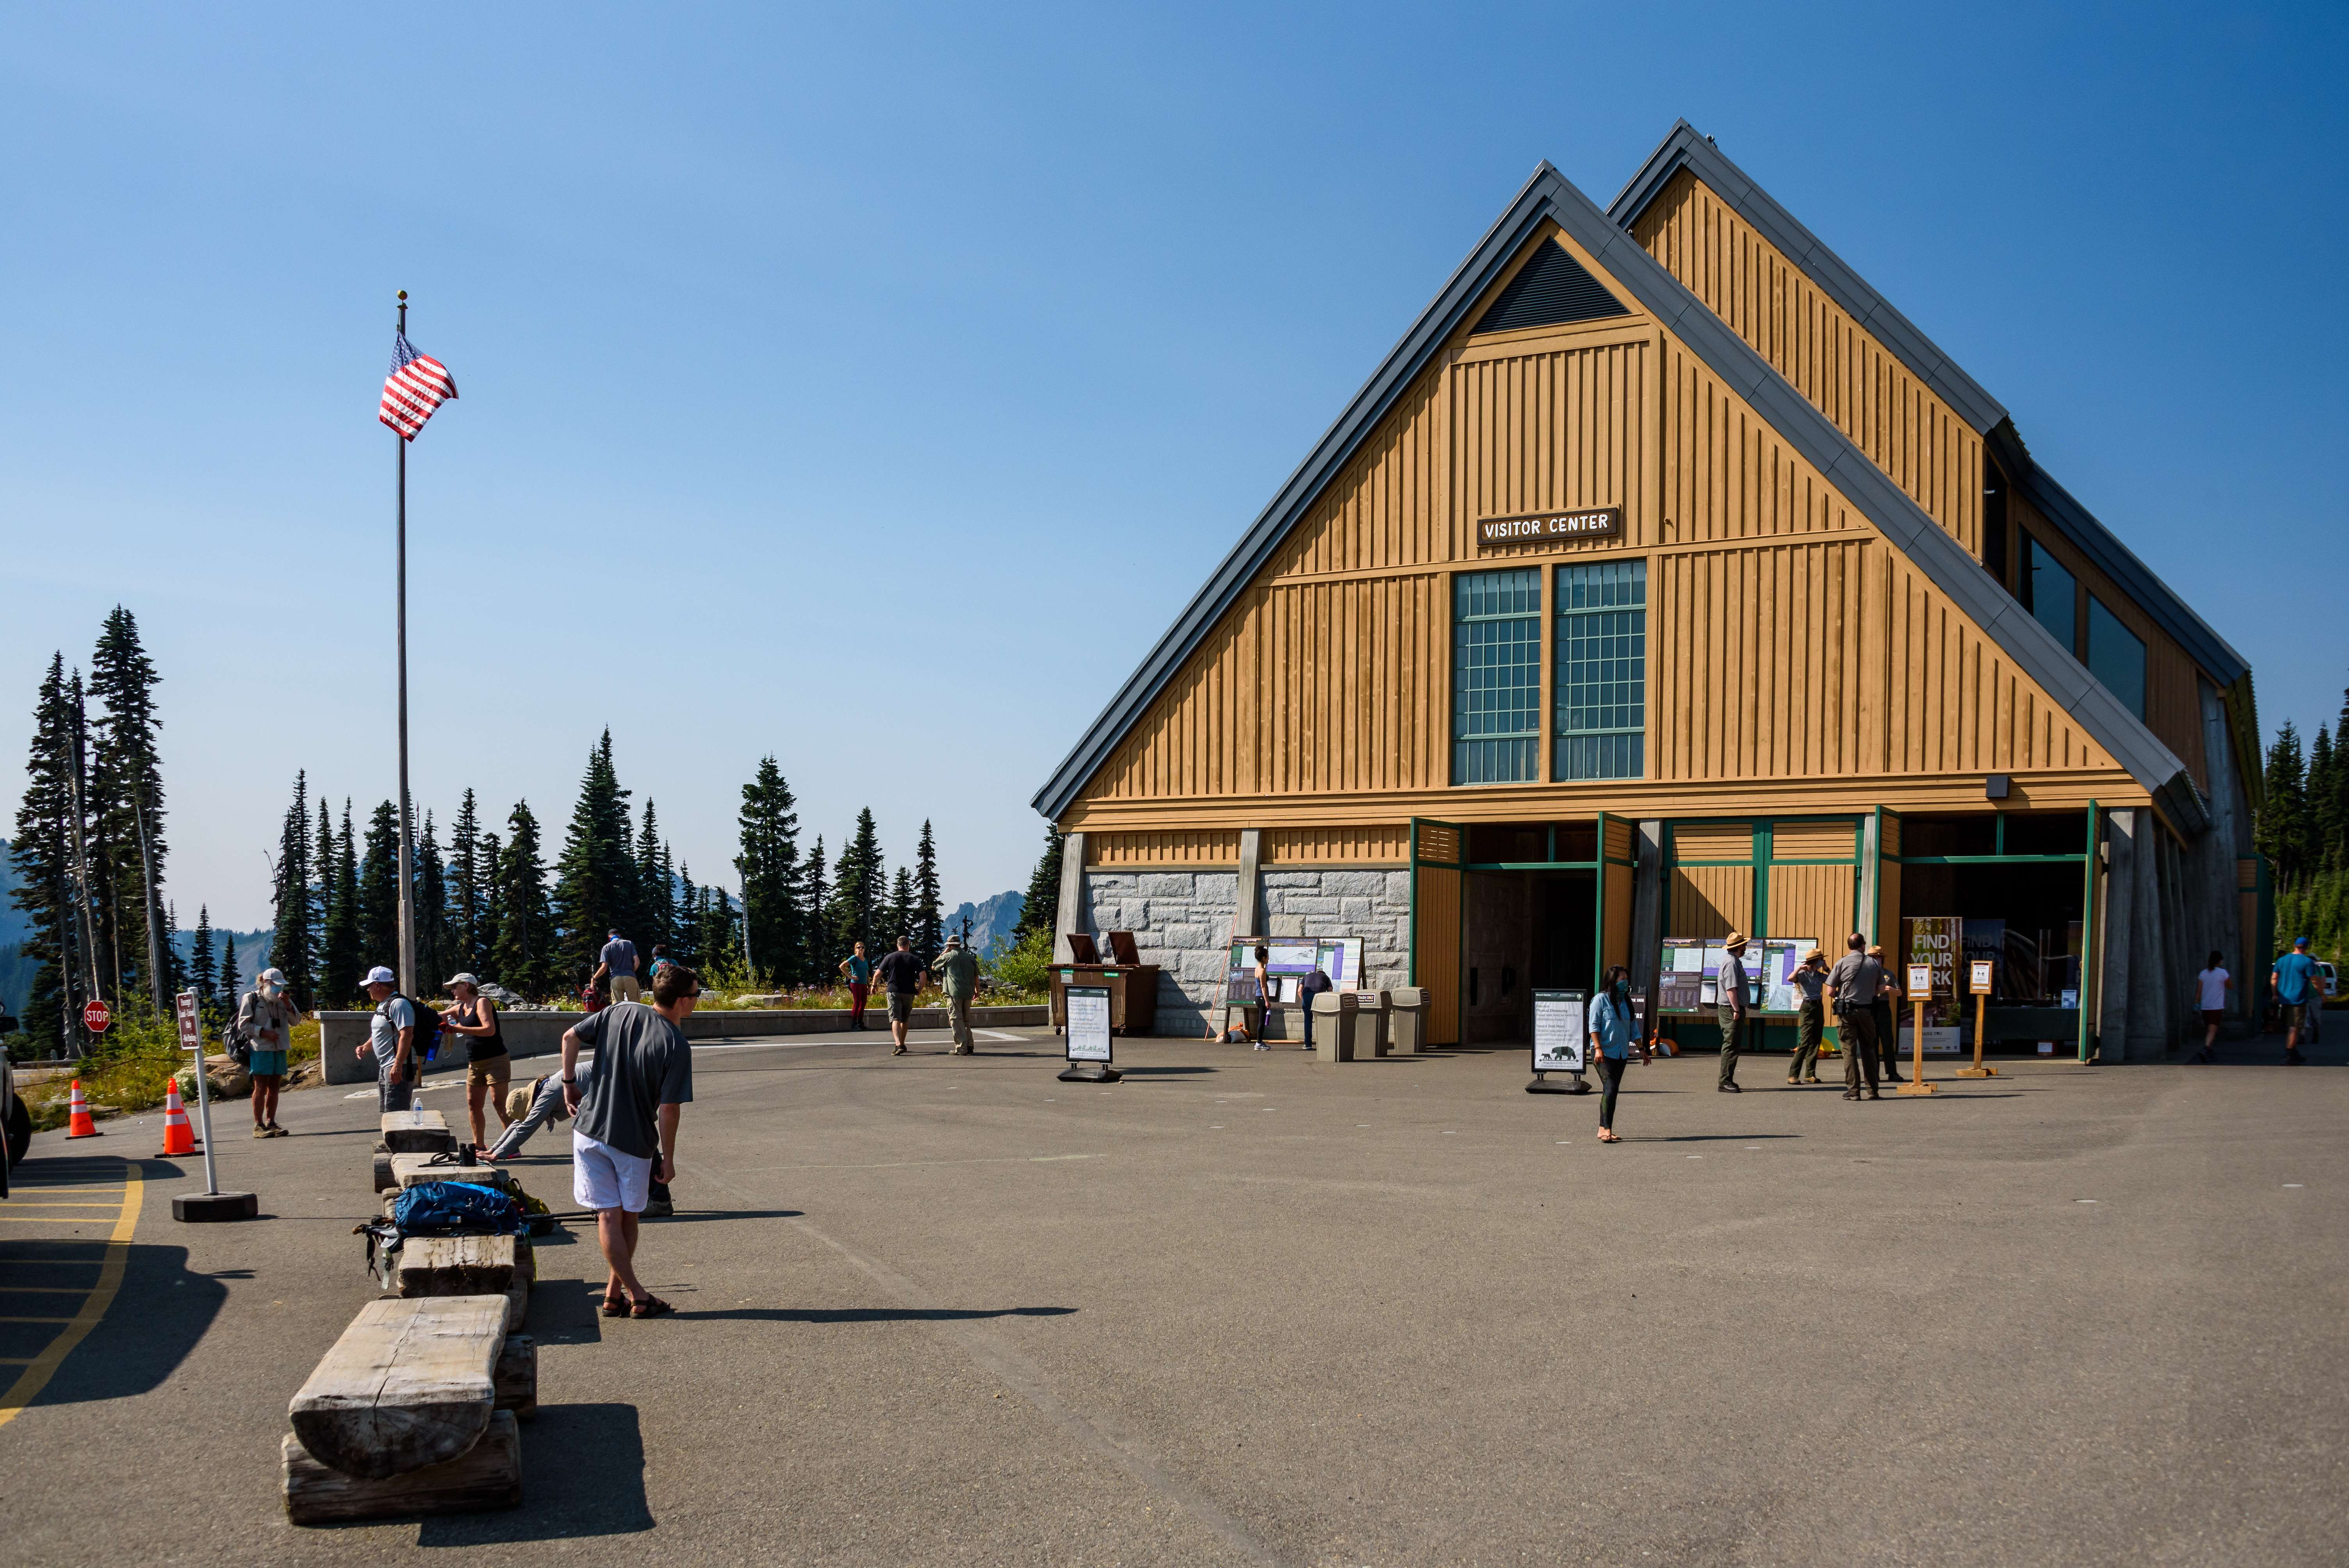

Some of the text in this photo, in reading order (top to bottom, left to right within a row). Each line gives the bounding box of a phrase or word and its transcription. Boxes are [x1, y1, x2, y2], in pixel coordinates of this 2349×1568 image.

[1485, 514, 1608, 538] VISITOR CENTER
[1914, 934, 1950, 949] FIND
[1910, 953, 1953, 967] YOUR
[1931, 971, 1952, 985] RK
[87, 1010, 109, 1022] STOP
